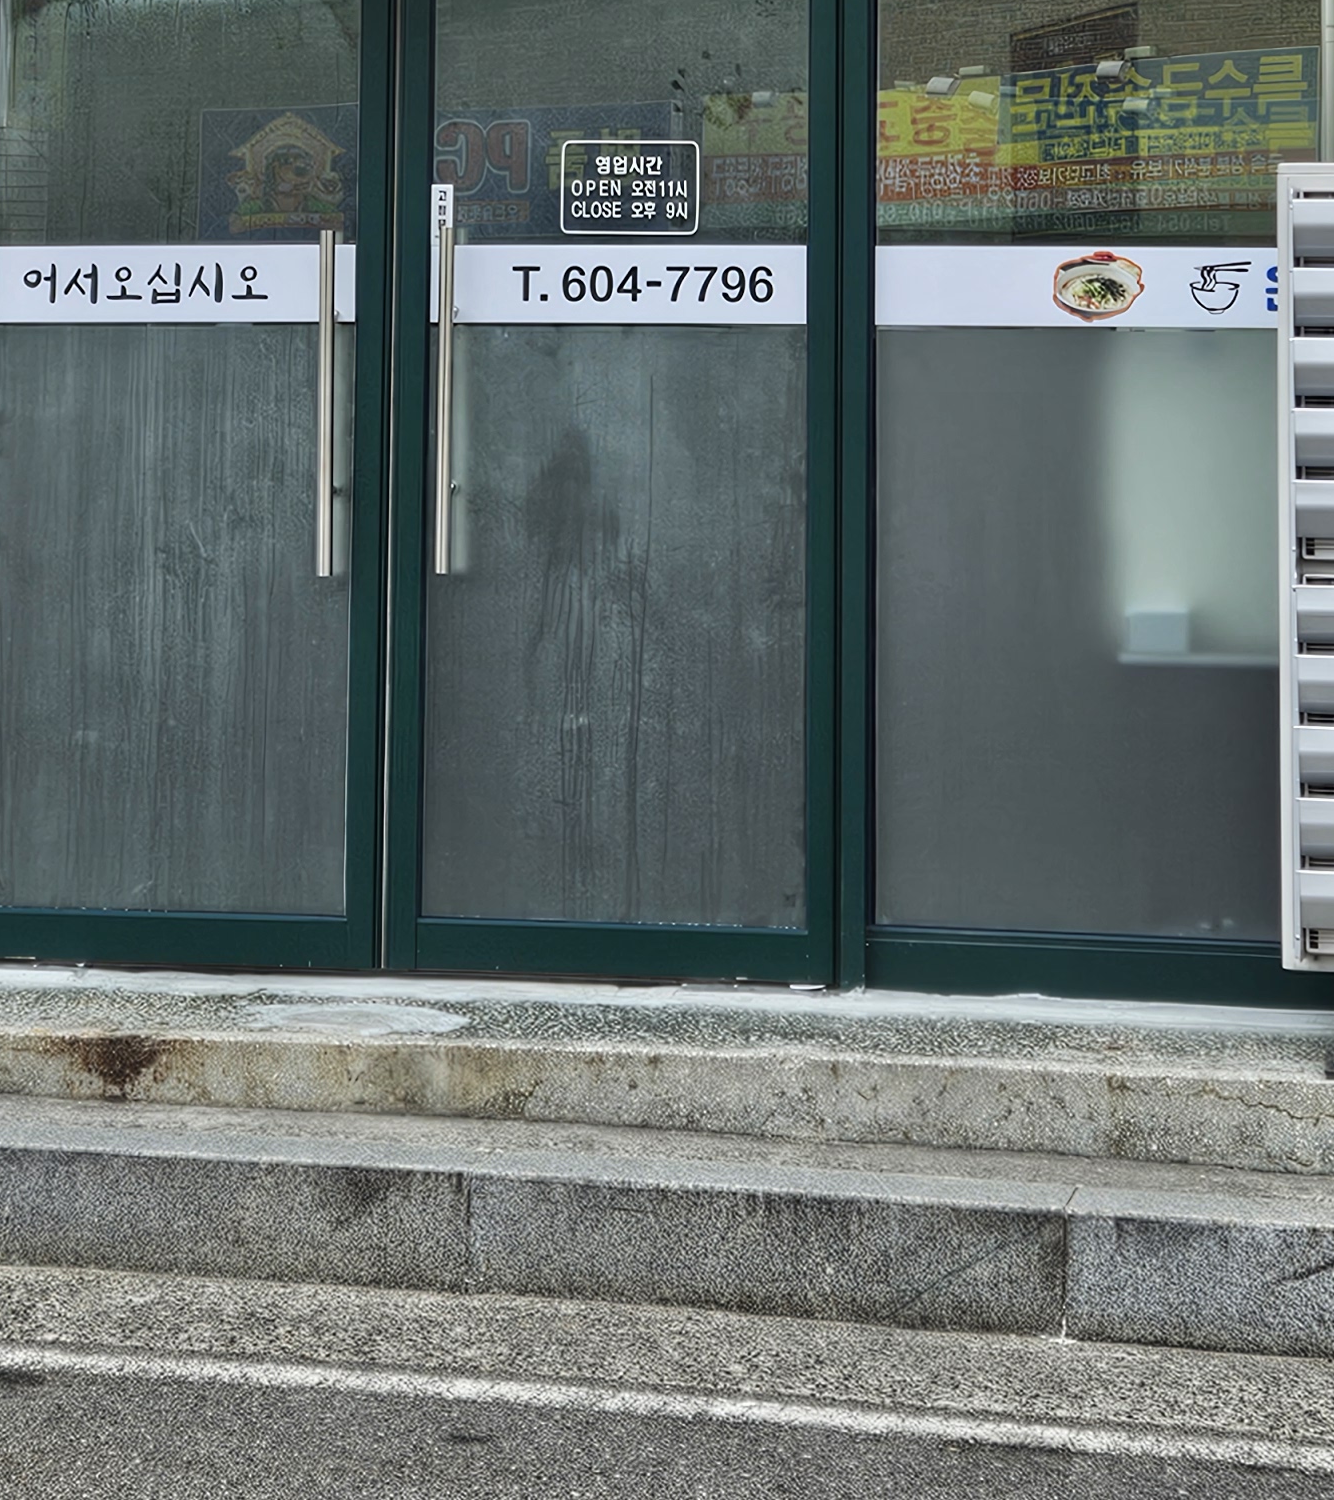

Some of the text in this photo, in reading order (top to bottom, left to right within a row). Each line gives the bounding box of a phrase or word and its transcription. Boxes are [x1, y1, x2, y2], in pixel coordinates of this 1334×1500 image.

[595, 156, 663, 175] 영업시간
[571, 180, 621, 197] OPEN
[571, 201, 688, 219] CLOSE 오후 9시
[23, 261, 269, 306] 어서오십시오
[512, 265, 774, 304] T. 604-7796
